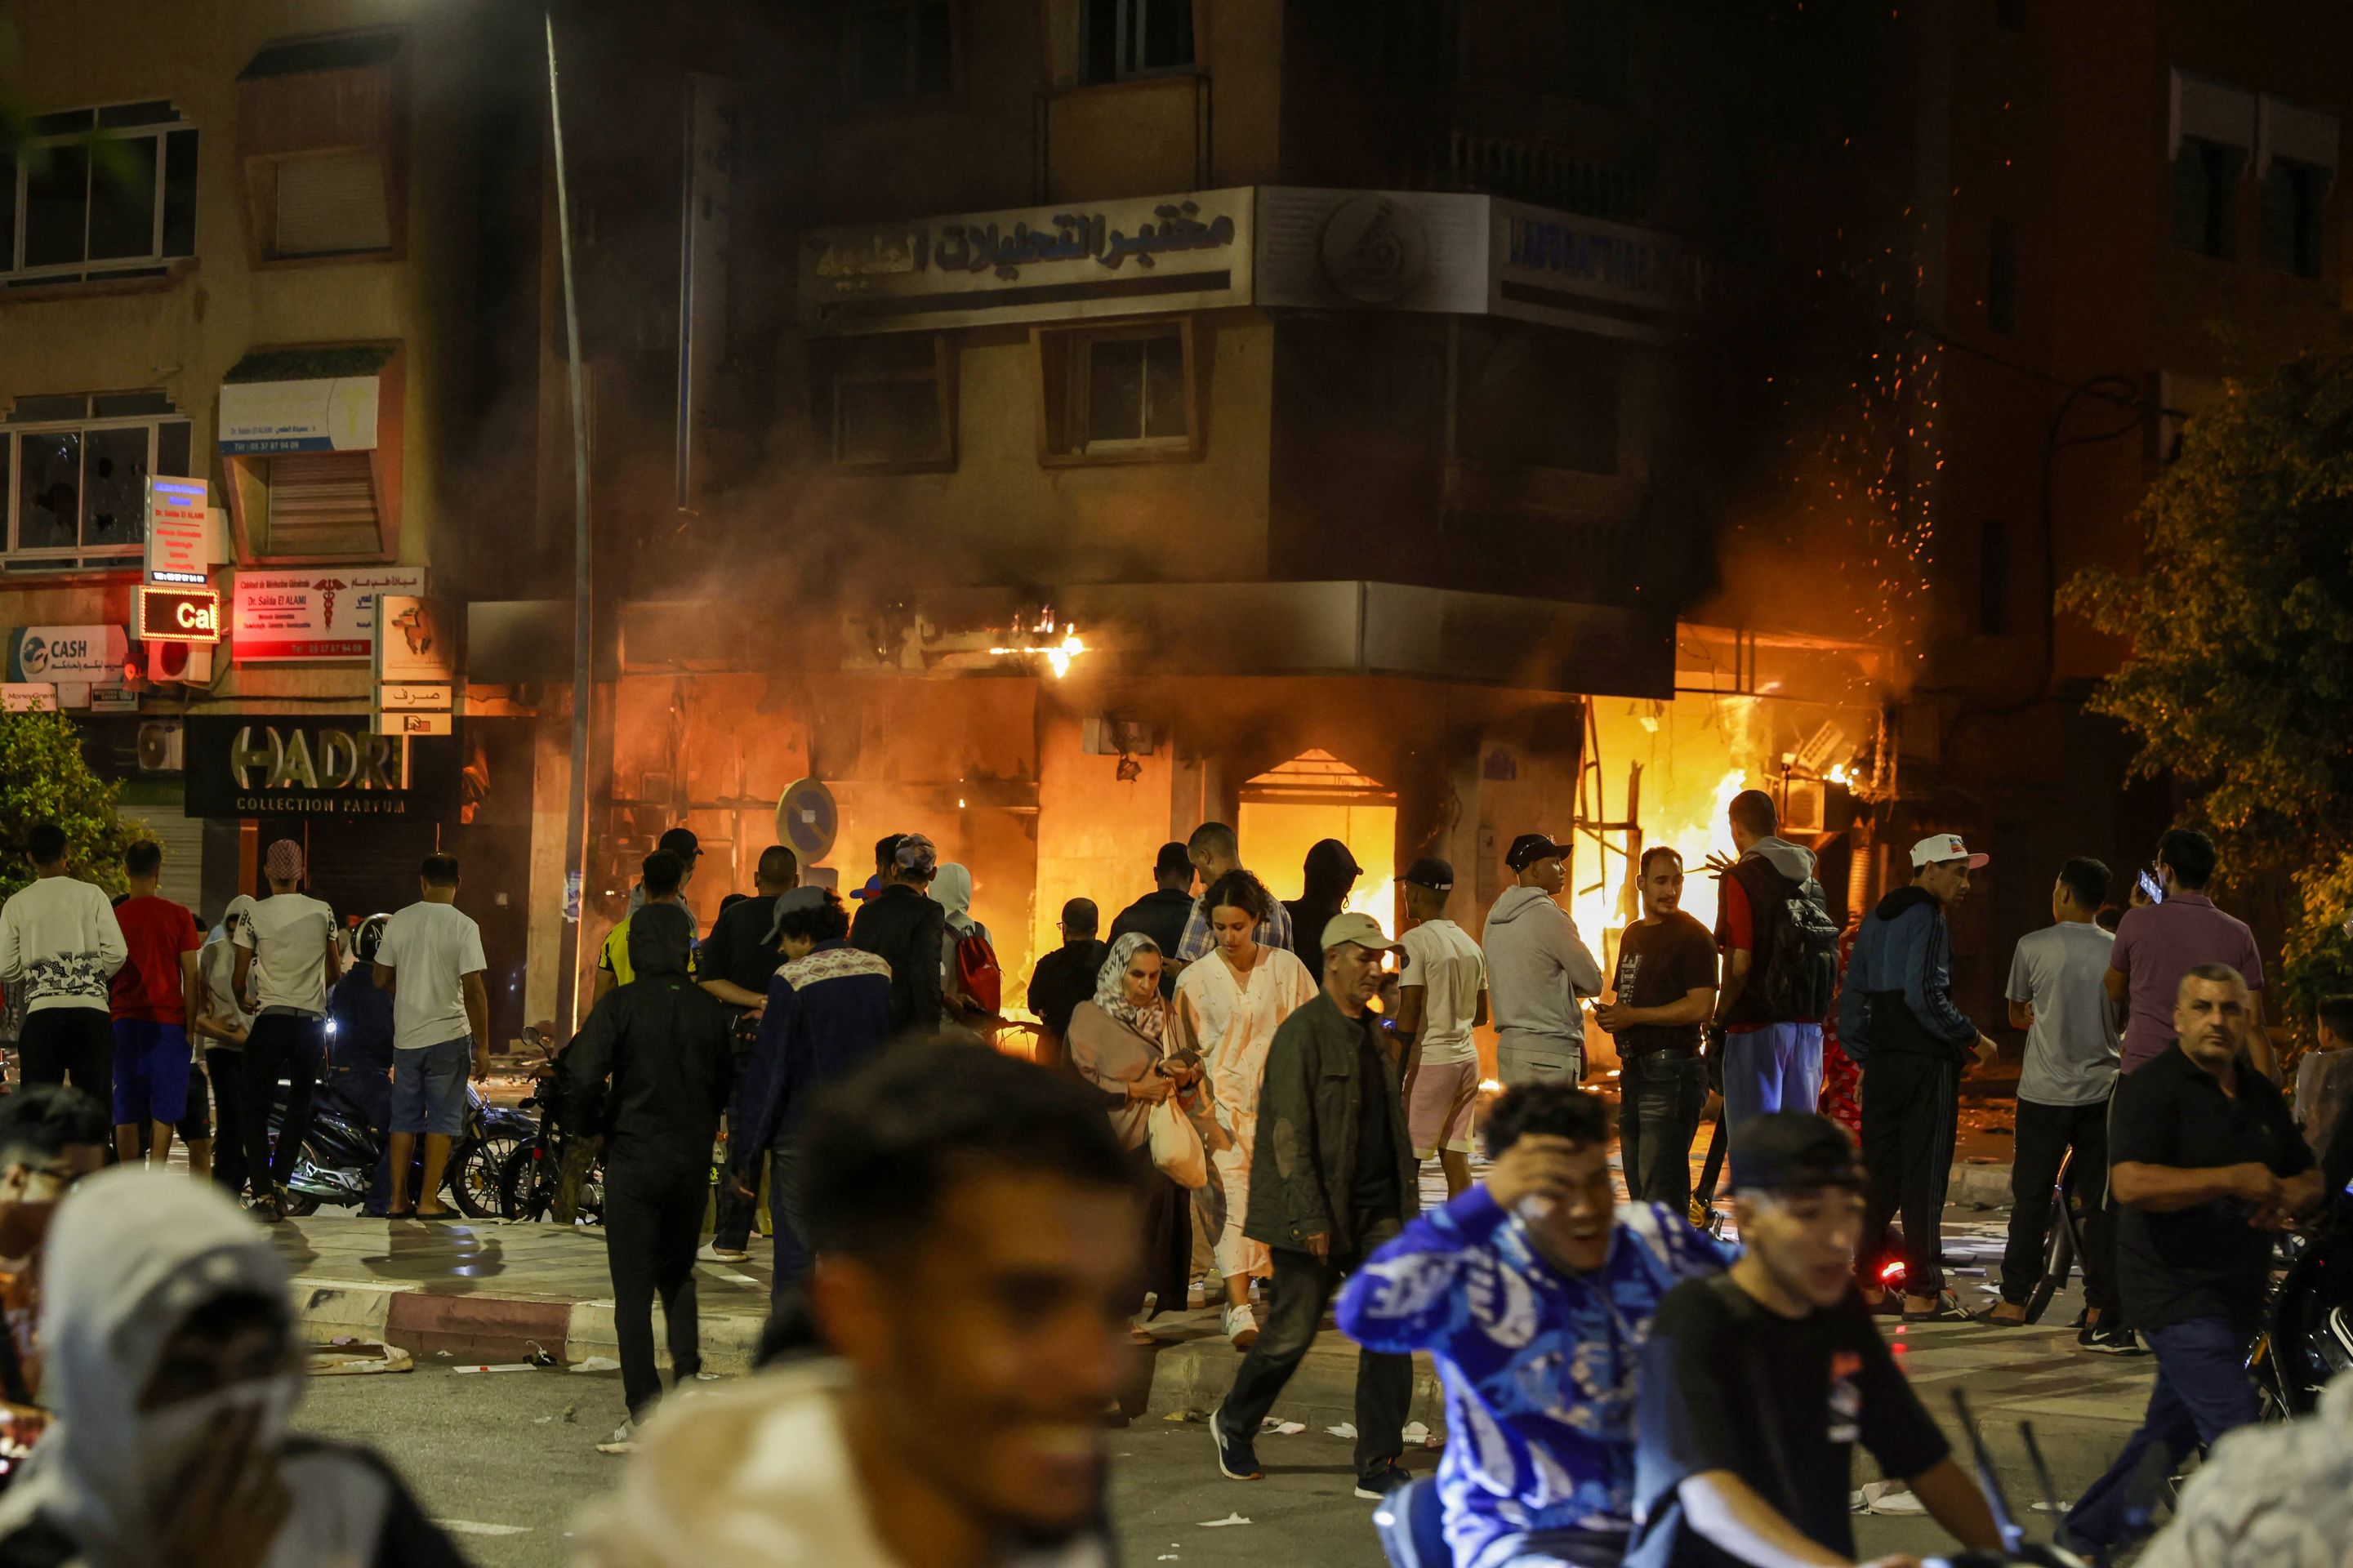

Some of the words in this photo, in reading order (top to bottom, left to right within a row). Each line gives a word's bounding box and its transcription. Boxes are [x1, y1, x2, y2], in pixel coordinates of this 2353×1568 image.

[1095, 200, 1235, 270] مختبر
[285, 595, 306, 605] ALAMI
[51, 639, 87, 658] CASH
[393, 688, 440, 705] صرف
[230, 725, 410, 790] HADRI
[237, 797, 334, 812] COLLECTION
[344, 799, 406, 813] PARFUM
